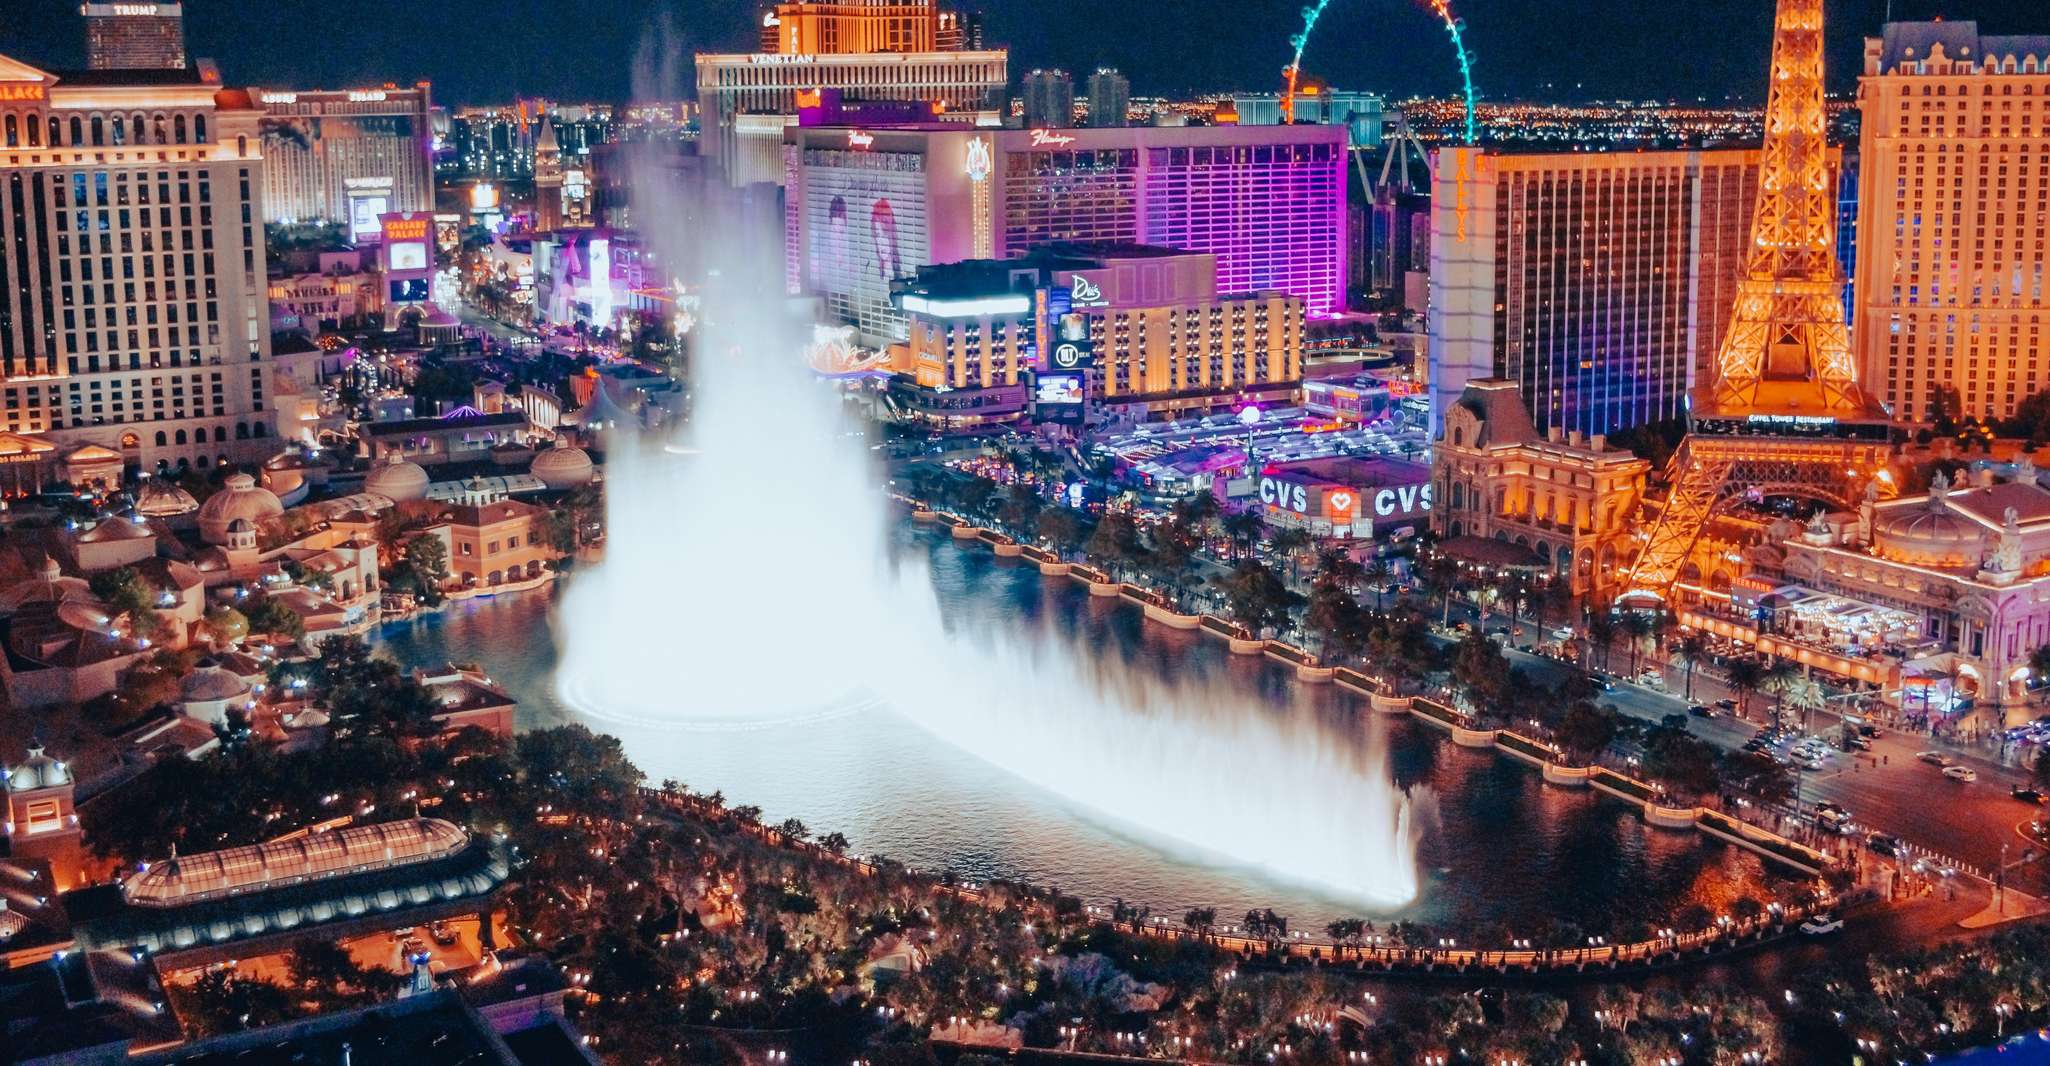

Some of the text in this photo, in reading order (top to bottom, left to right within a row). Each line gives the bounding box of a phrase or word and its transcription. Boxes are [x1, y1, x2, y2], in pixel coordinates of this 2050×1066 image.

[113, 4, 158, 16] TRUMP
[751, 53, 814, 64] VENETIAN
[1030, 128, 1076, 147] Flamingo
[385, 220, 427, 231] CAESARS
[387, 230, 426, 240] PALACE
[1748, 414, 1834, 425] EIFFEL TOWER RESTAURANT
[1259, 477, 1307, 513] CVS
[1375, 484, 1432, 516] CVS
[1731, 577, 1771, 593] BEER PARK
